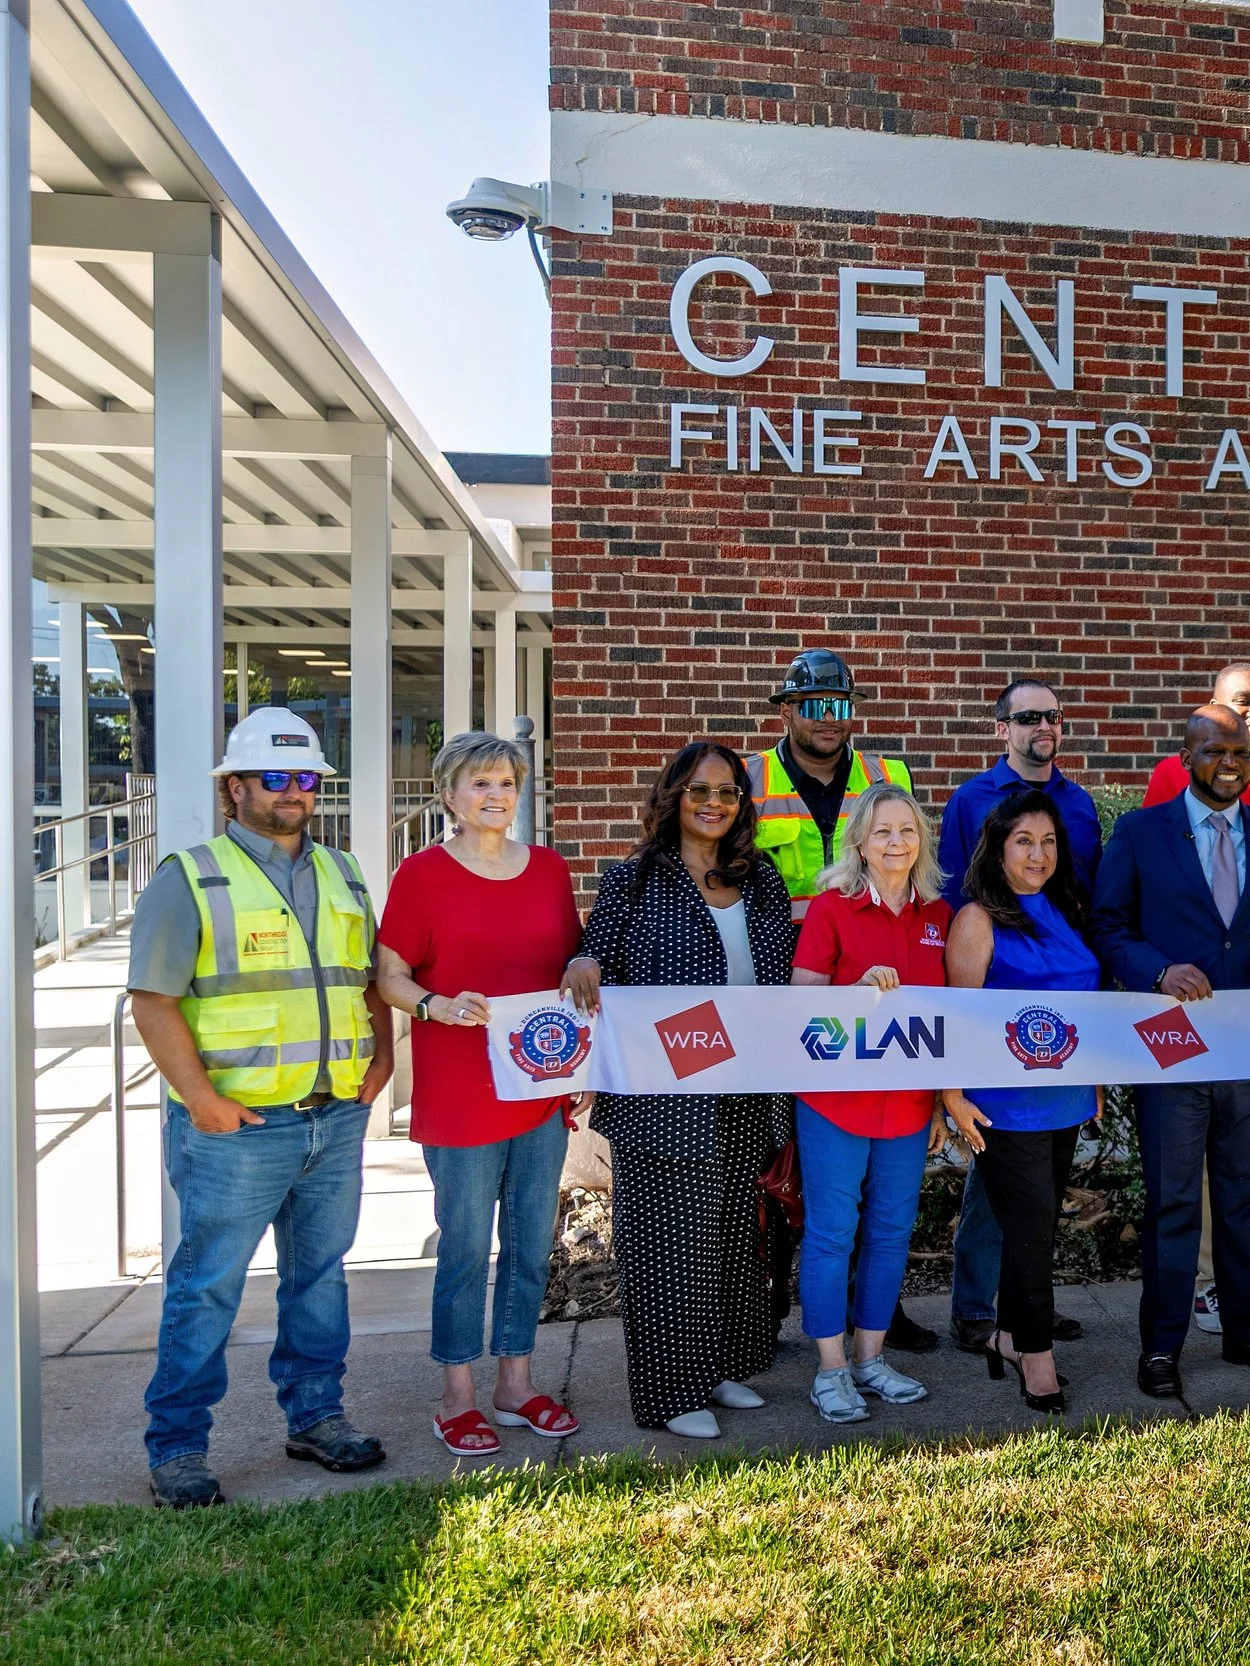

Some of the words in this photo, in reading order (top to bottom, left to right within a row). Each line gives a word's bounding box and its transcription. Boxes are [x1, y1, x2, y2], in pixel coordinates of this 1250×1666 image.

[670, 403, 863, 476] FINE
[923, 415, 1153, 488] ARTS
[521, 1006, 565, 1025] DUNCANVILLE
[528, 1015, 570, 1032] CENTRAL
[1022, 1012, 1058, 1025] CENTRAL
[664, 1031, 727, 1049] WRA
[855, 1015, 945, 1060] LAN
[1142, 1030, 1200, 1045] WRA
